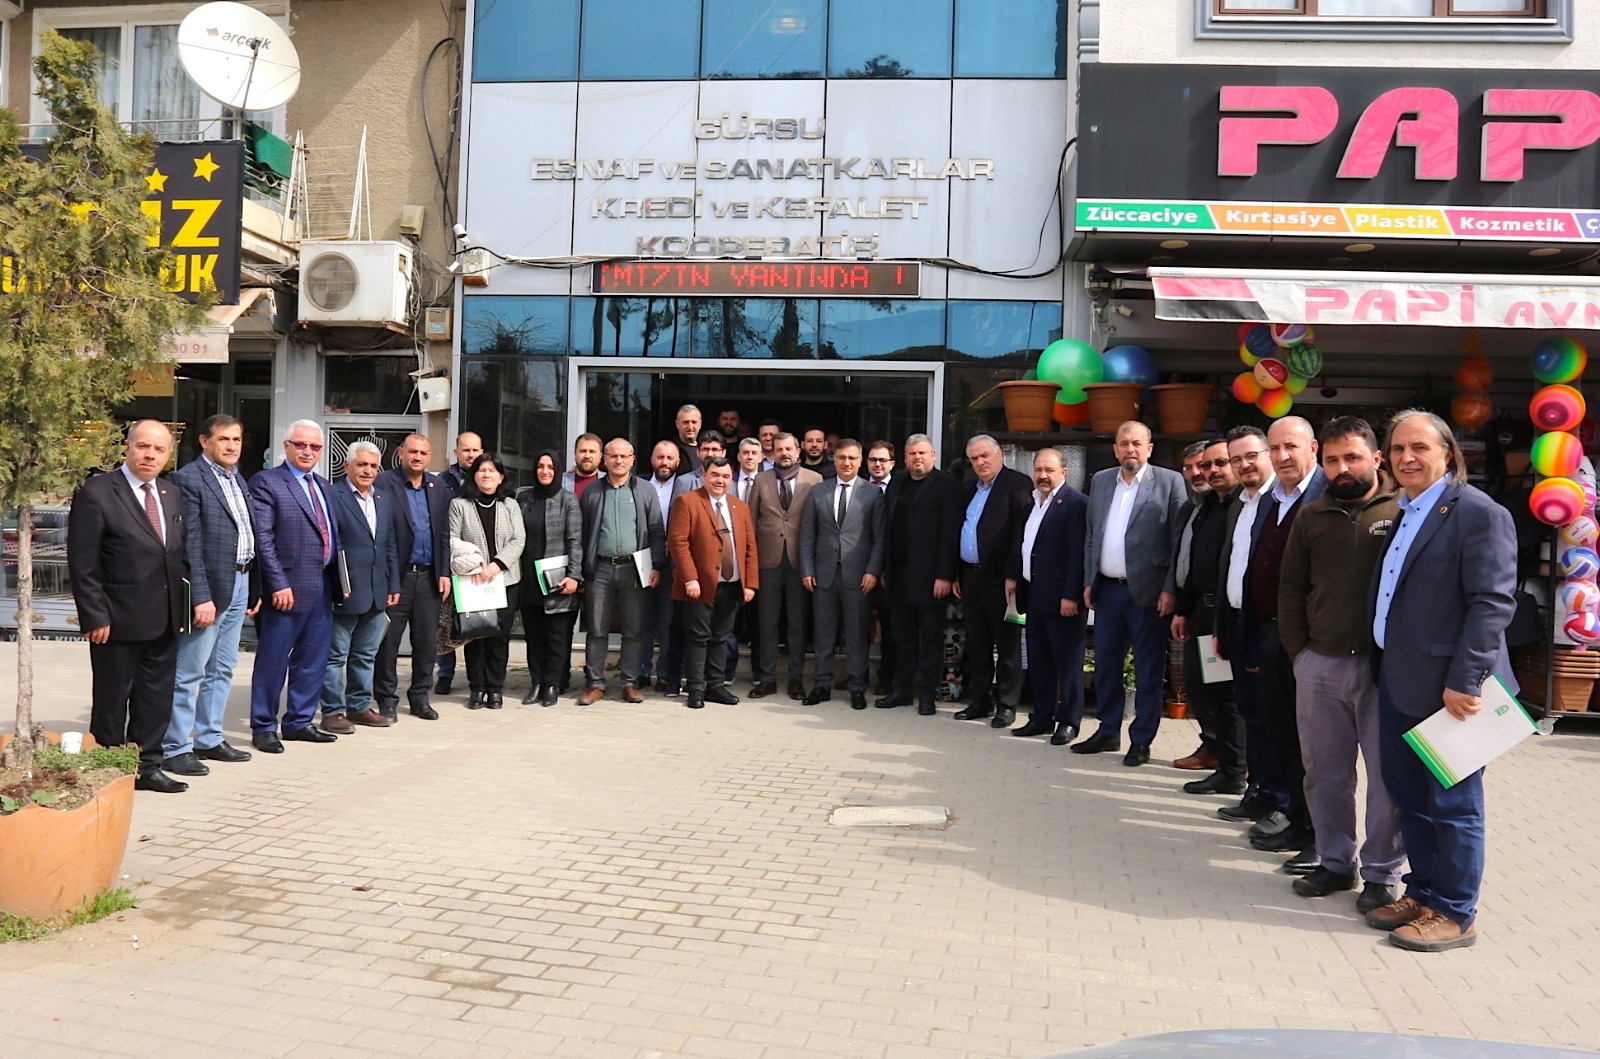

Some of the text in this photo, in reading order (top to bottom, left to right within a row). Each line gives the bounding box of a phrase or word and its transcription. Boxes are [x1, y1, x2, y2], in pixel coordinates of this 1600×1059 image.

[222, 31, 271, 50] arçeik
[694, 112, 826, 140] GÜRSU
[1218, 86, 1600, 181] PAP
[531, 157, 995, 181] ESNAF VE SANATKARLAR
[592, 189, 929, 219] KREDİ VE KEFALET
[1086, 207, 1600, 234] Züccaciye Kırtasiye Plastik Kozmetik Ç
[636, 230, 880, 258] KOOPERATİFİ
[1305, 285, 1475, 324] PAPİ
